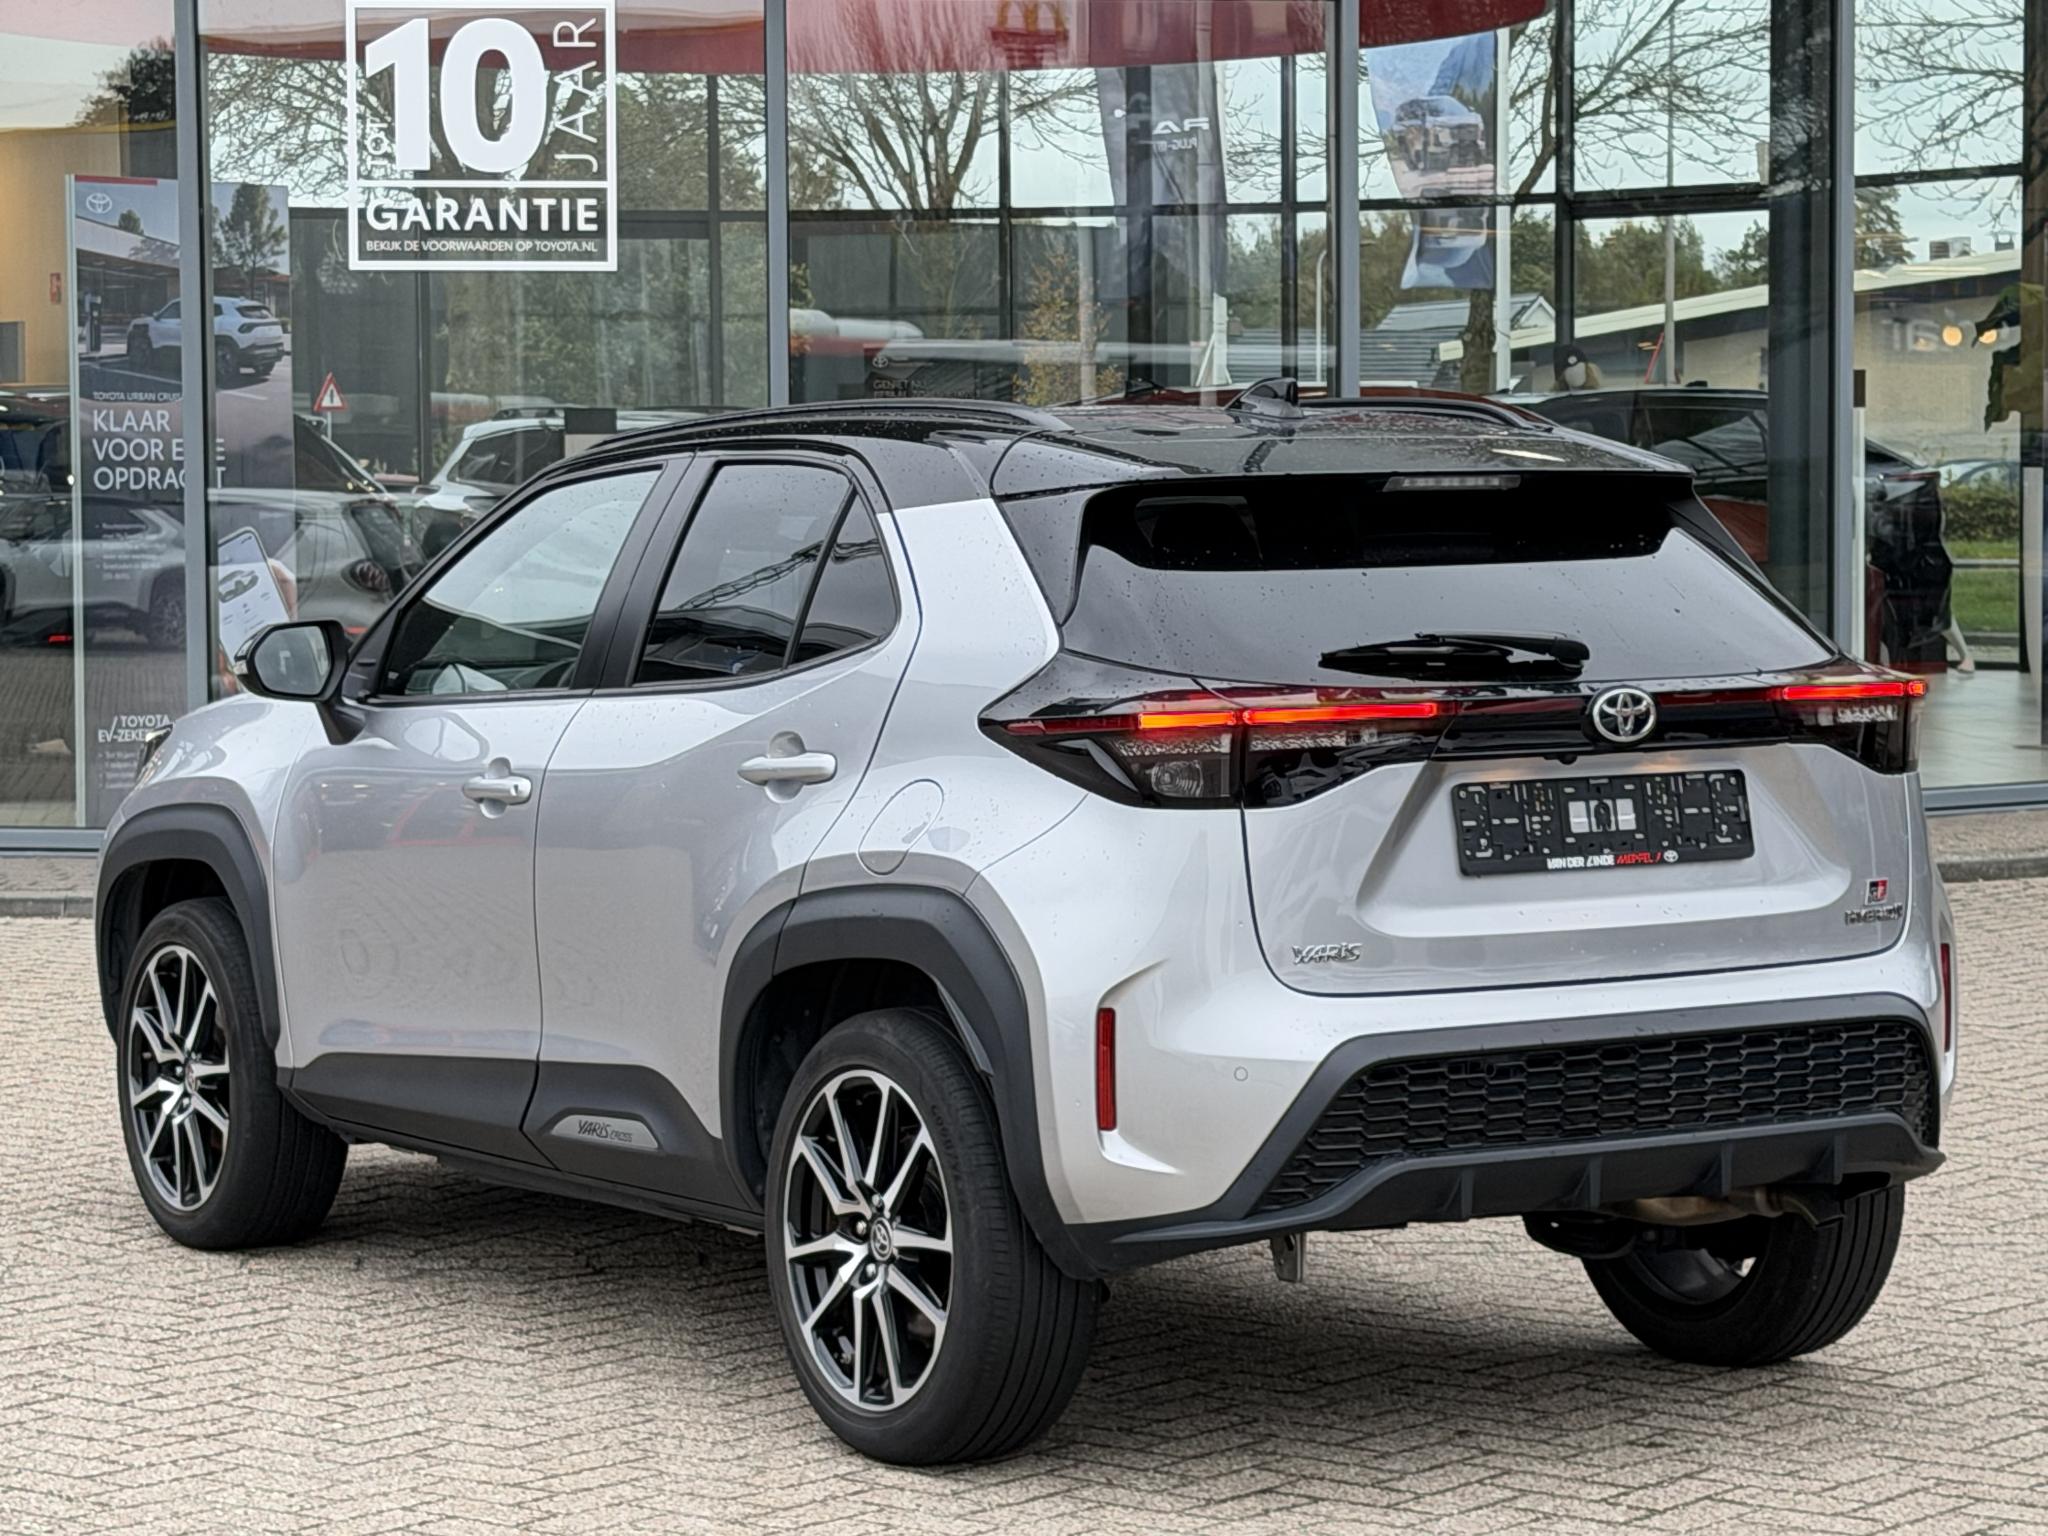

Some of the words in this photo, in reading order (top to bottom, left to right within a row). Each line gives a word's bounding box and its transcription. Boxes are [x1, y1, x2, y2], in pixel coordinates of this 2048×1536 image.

[365, 17, 548, 174] 10
[552, 17, 598, 174] JAAR
[366, 116, 389, 171] TOT
[366, 197, 599, 232] GARANTIE
[366, 240, 402, 252] BEKIJK
[404, 240, 419, 252] DE
[421, 239, 513, 252] VOORWAARDEN
[515, 240, 532, 252] OP
[535, 240, 598, 253] TOYOTA.NL
[93, 391, 125, 401] TOYOTA
[127, 391, 156, 401] URBAN
[93, 409, 171, 432] KLAAR
[92, 438, 164, 461] VOOR
[120, 714, 171, 728] TOYOTA
[1547, 857, 1566, 869] VAN
[1567, 856, 1585, 868] DER
